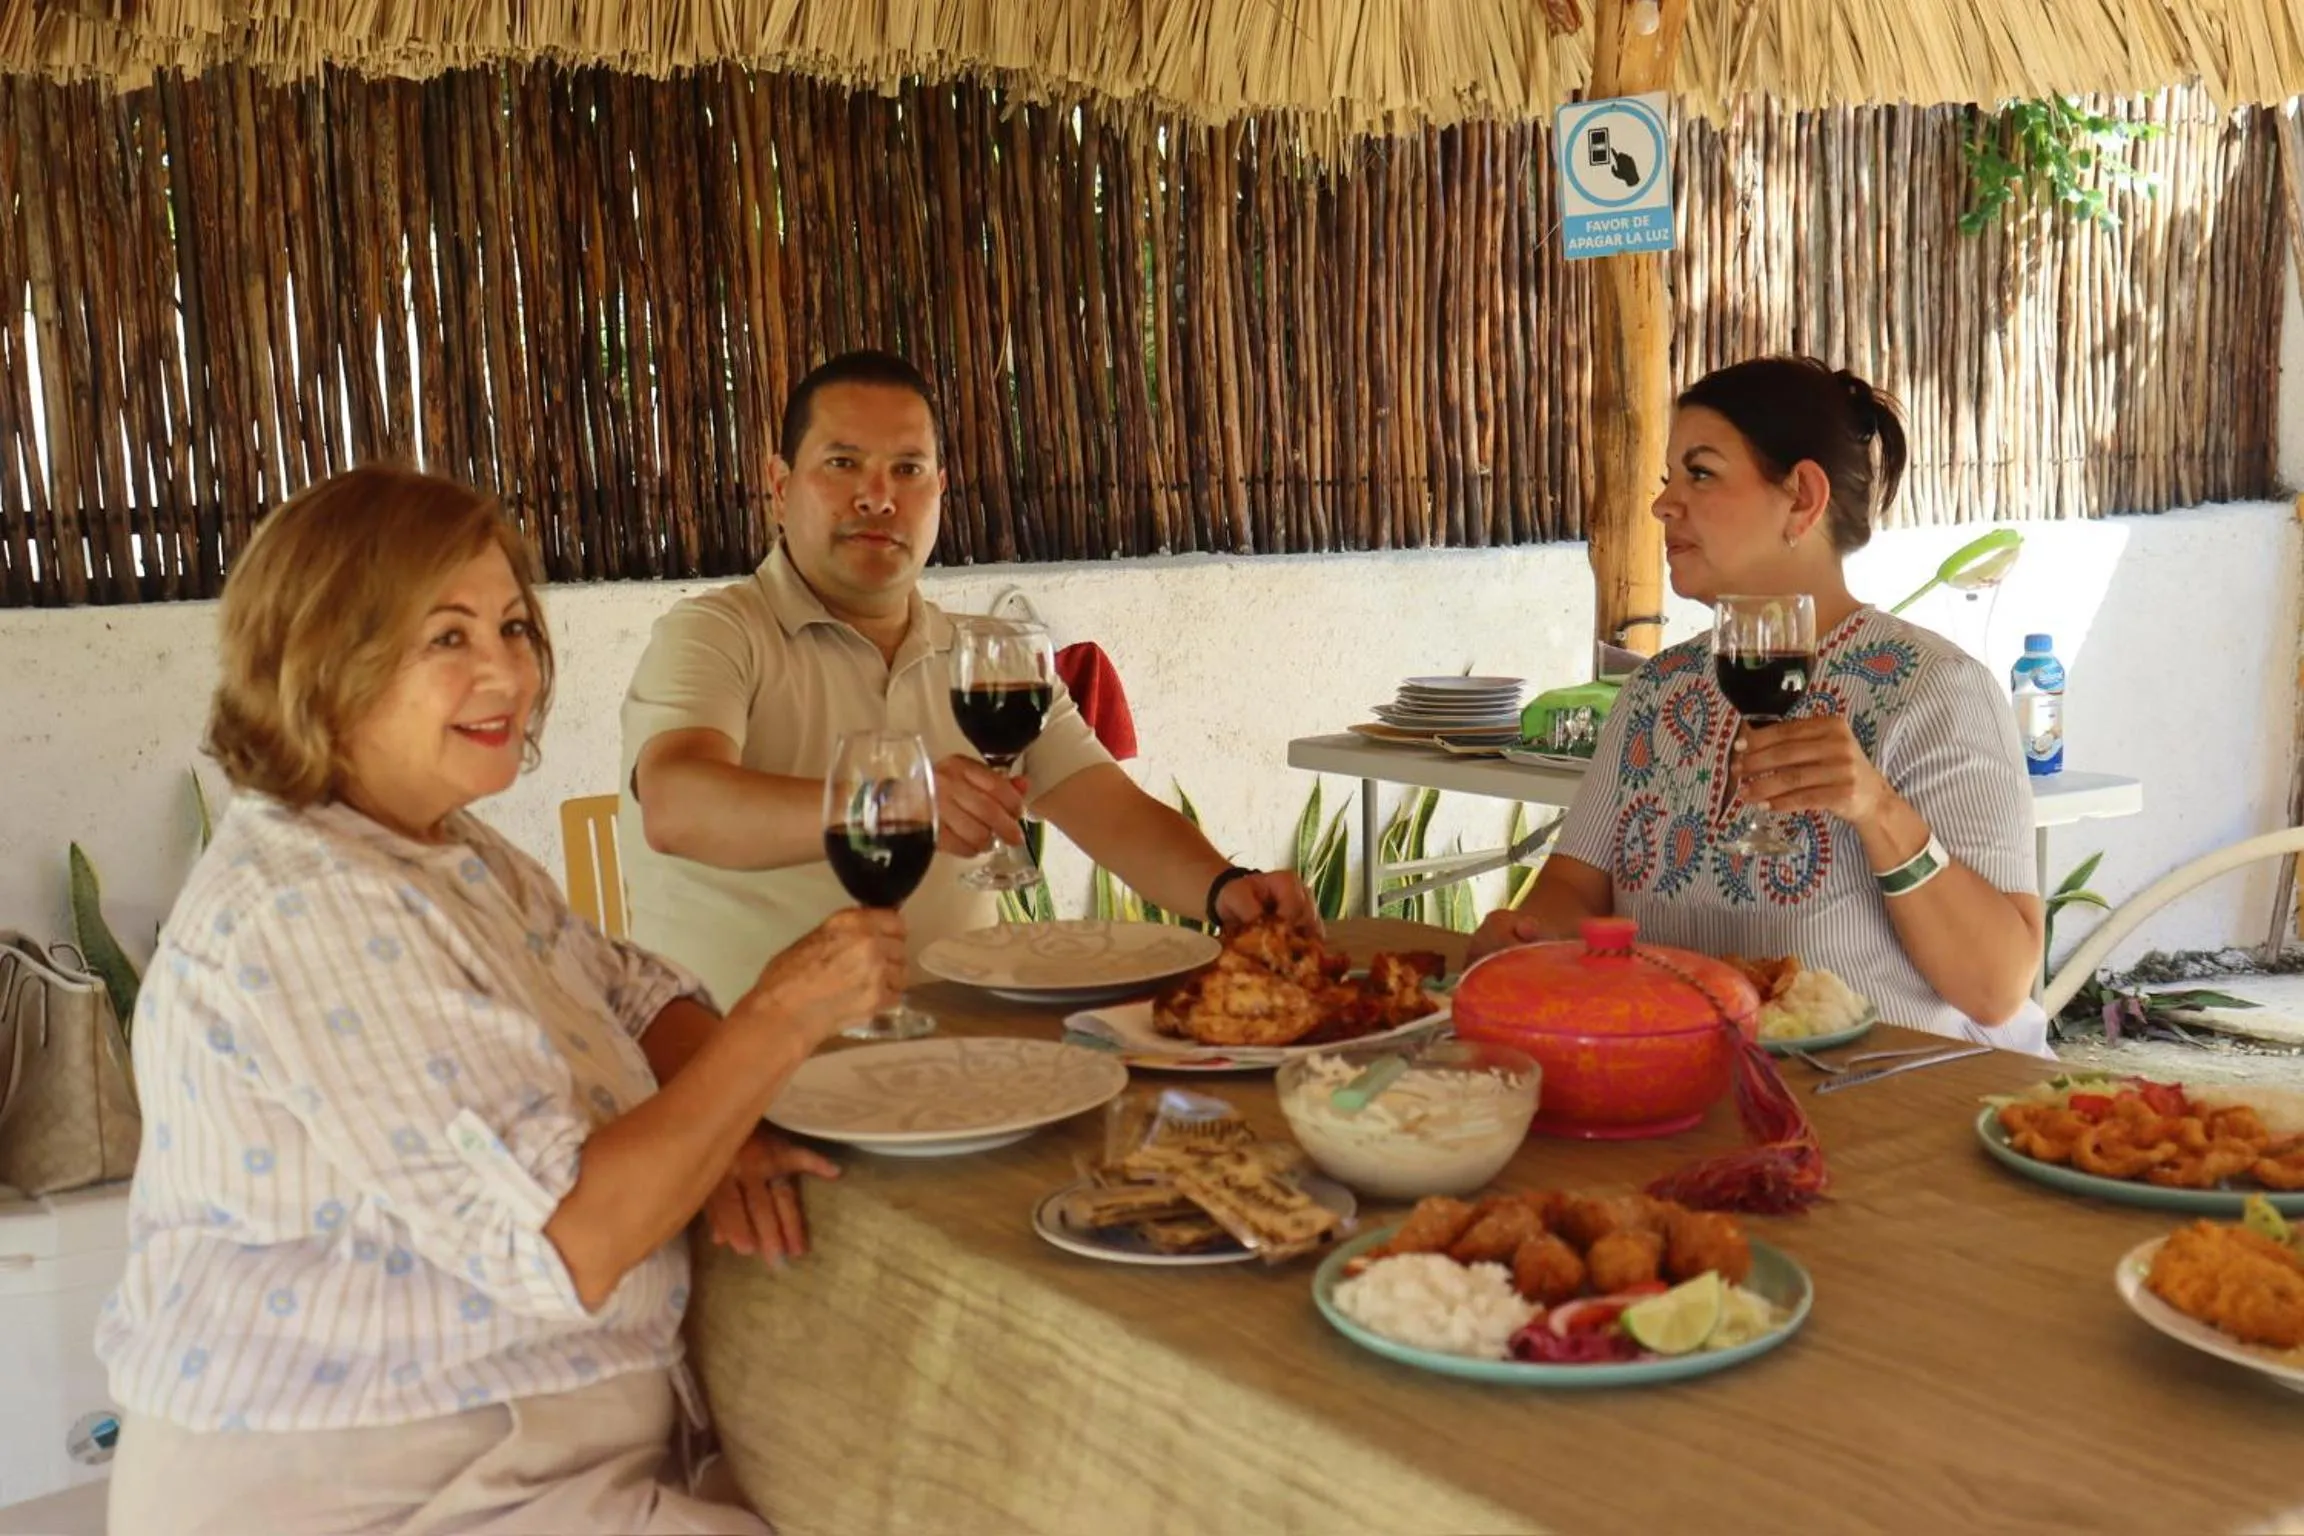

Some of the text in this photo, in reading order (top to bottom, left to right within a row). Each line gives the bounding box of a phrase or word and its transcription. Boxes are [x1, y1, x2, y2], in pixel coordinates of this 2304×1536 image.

[1586, 215, 1650, 233] FAVOR DE
[1568, 228, 1669, 250] APAGAR LA LUZ
